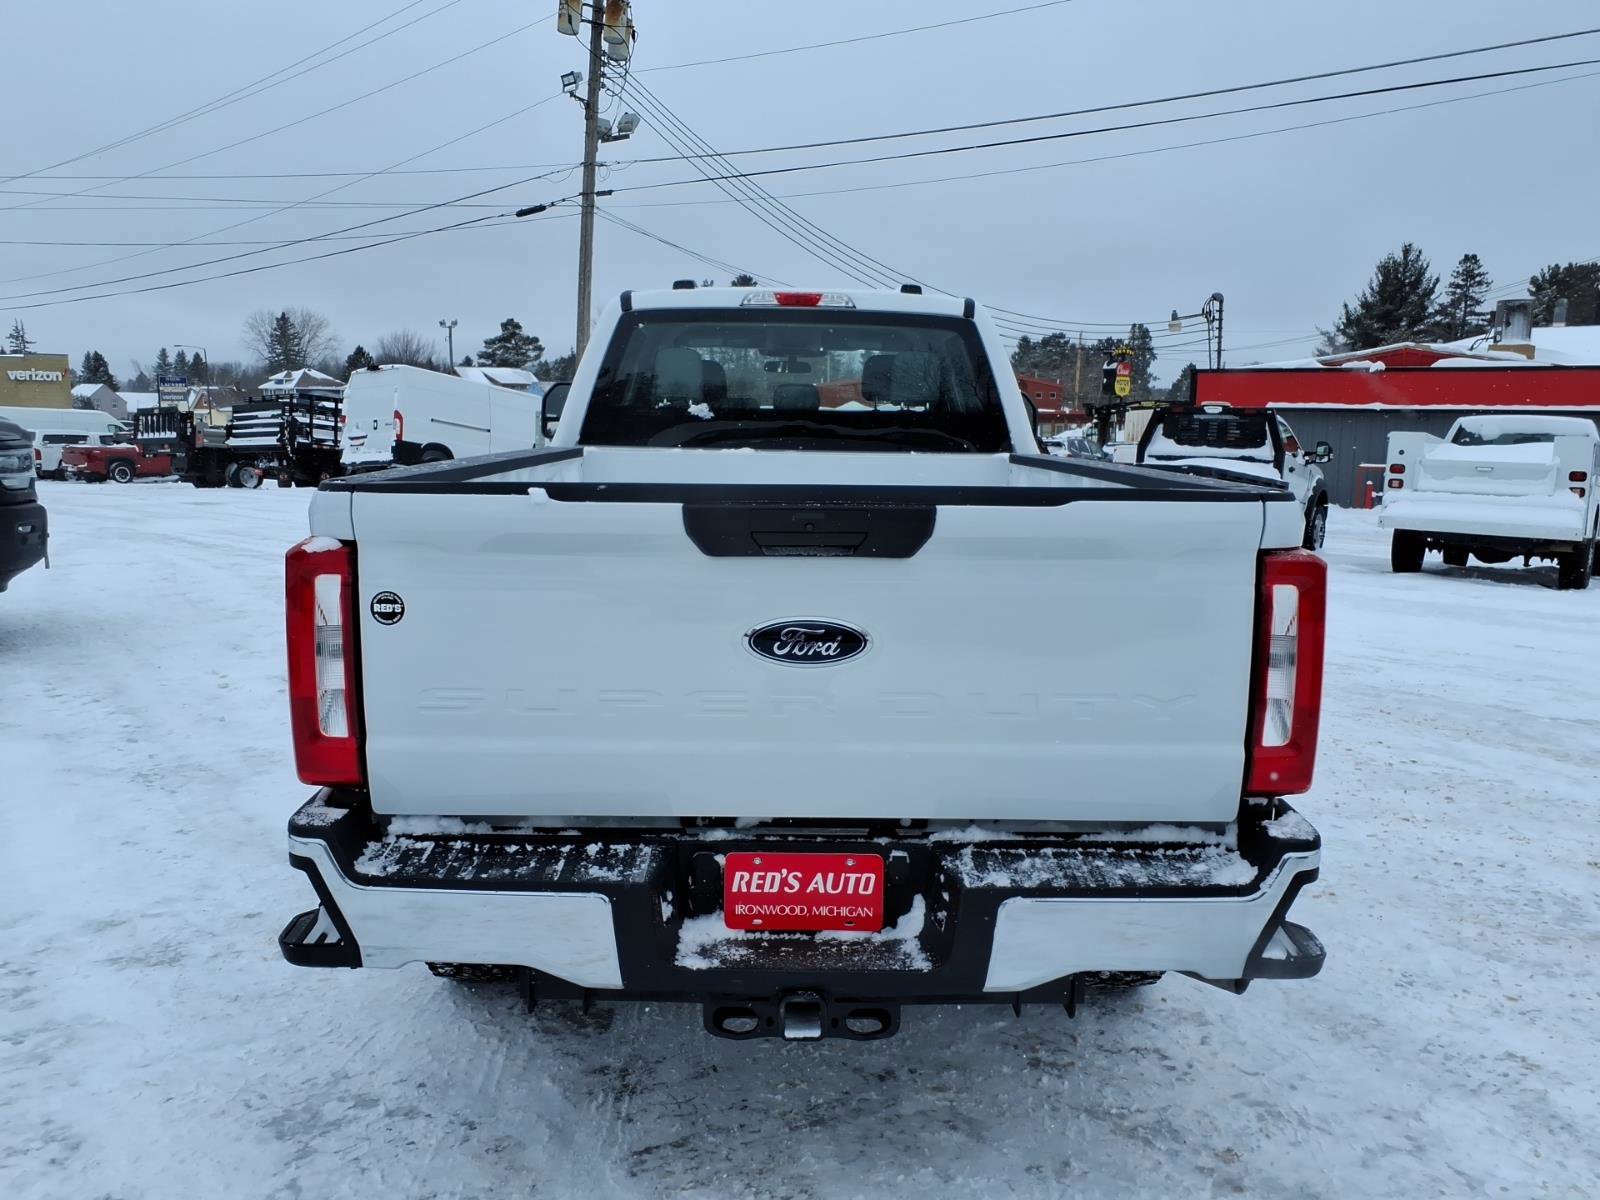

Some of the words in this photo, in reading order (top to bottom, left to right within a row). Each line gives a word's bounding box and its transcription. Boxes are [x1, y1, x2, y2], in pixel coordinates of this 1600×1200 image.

[6, 367, 63, 382] verizon
[373, 603, 402, 613] RED'S
[773, 627, 842, 656] Ford
[416, 687, 838, 719] SUPER
[878, 690, 1199, 721] DUTY
[731, 868, 803, 893] RED'S
[806, 872, 876, 895] AUTO
[735, 904, 810, 917] IRONWOOD,
[812, 906, 874, 918] MICHIGAN
